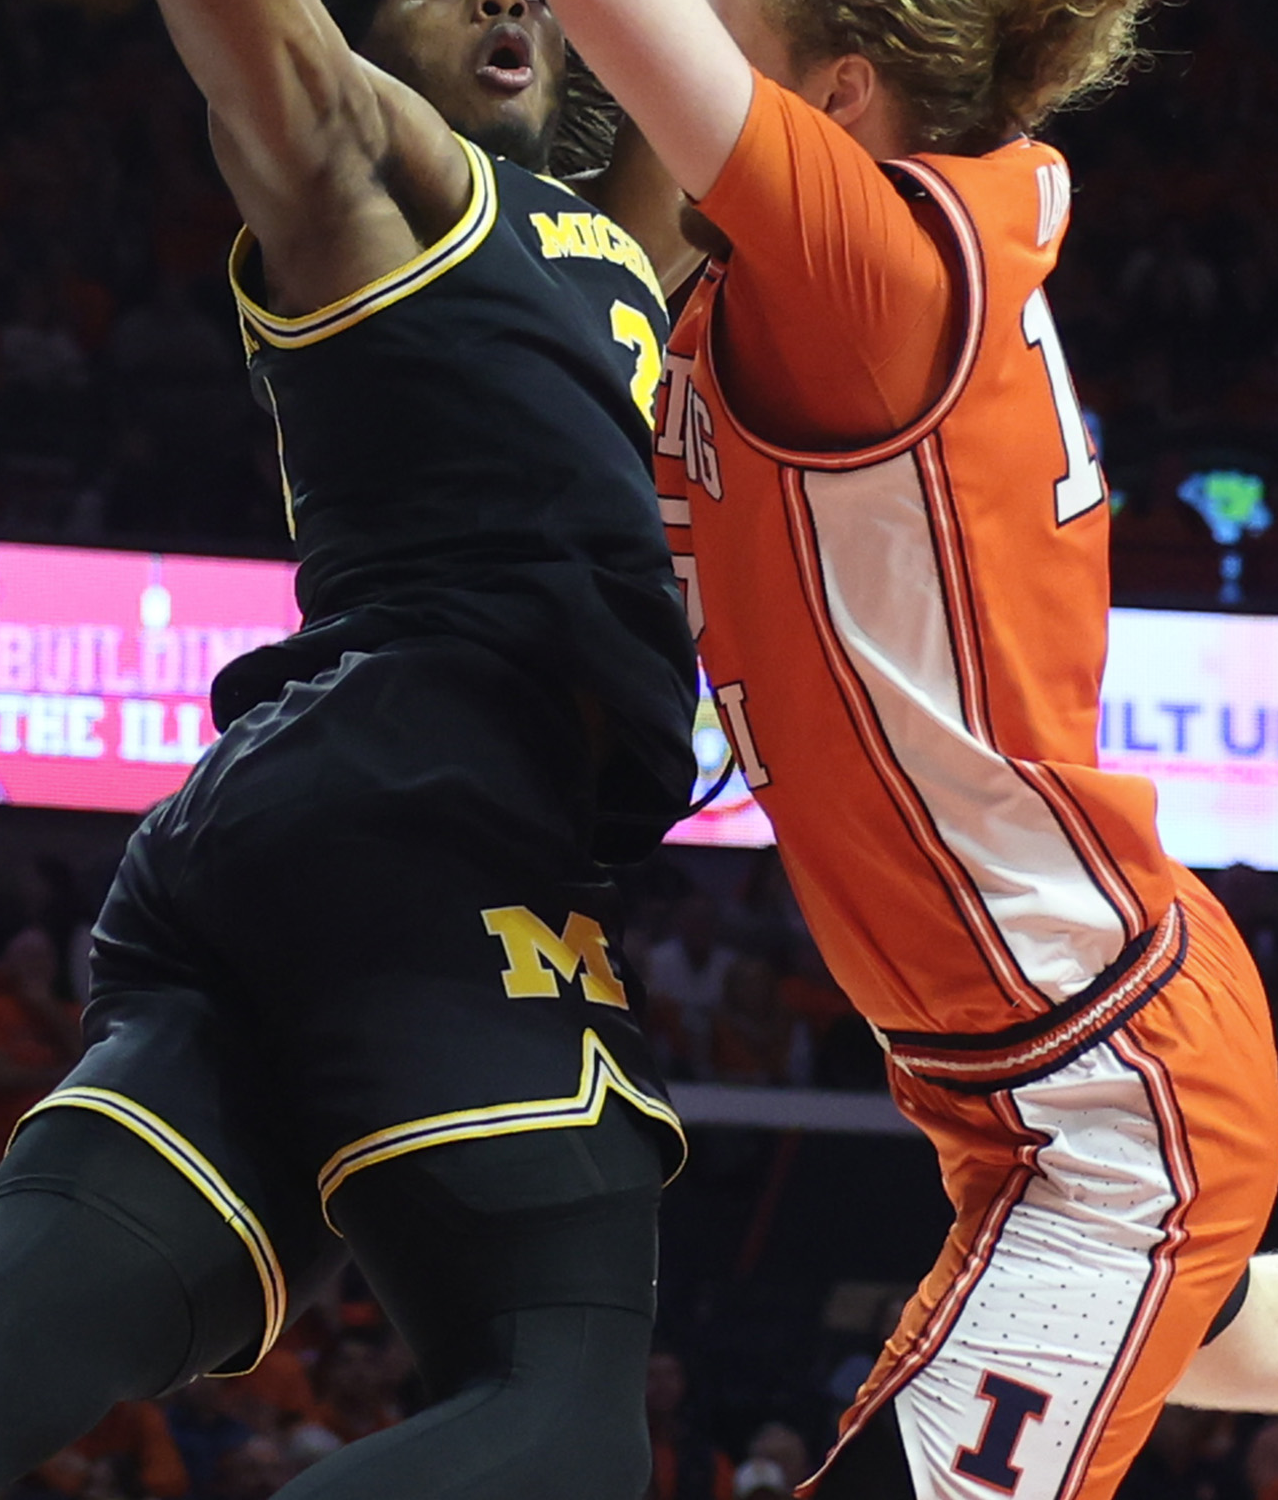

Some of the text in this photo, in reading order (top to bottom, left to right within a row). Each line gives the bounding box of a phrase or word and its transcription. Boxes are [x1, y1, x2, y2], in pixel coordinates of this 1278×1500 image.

[118, 699, 218, 764] ILL
[1098, 702, 1200, 753] ILT
[481, 905, 629, 1011] M
[949, 1369, 1052, 1496] I
